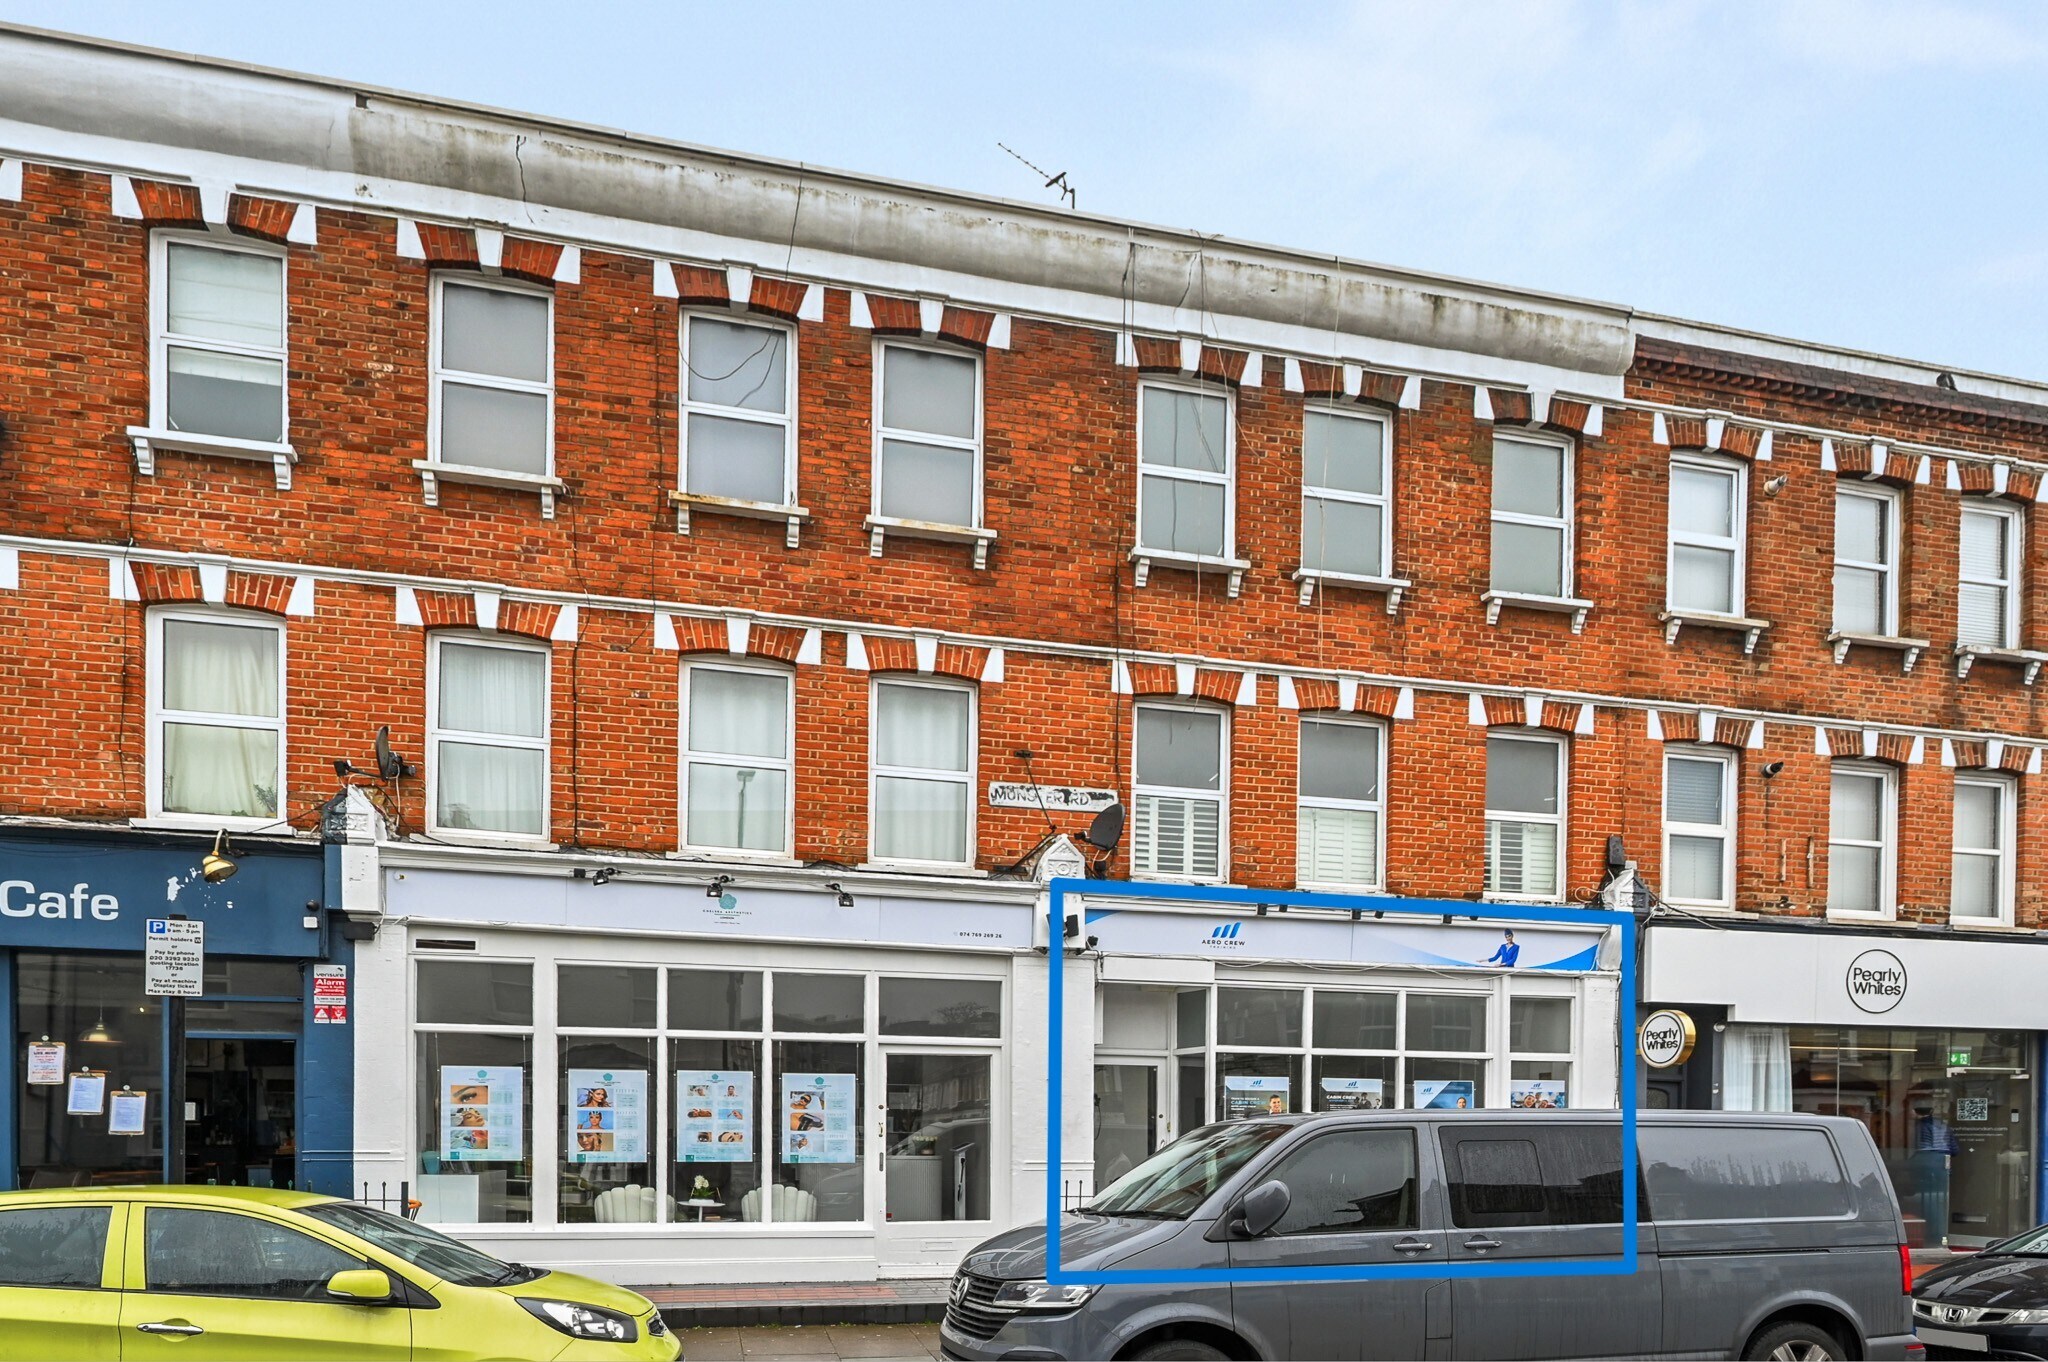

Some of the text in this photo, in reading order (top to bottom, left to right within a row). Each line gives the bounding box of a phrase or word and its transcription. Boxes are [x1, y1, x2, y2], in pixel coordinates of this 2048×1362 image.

[992, 786, 1062, 805] MUNSER
[0, 880, 119, 920] Cafe
[153, 922, 163, 932] P
[1853, 967, 1901, 984] Pearly
[1853, 981, 1901, 996] Whites
[1646, 1028, 1678, 1040] Pearly
[1646, 1040, 1678, 1050] Whites
